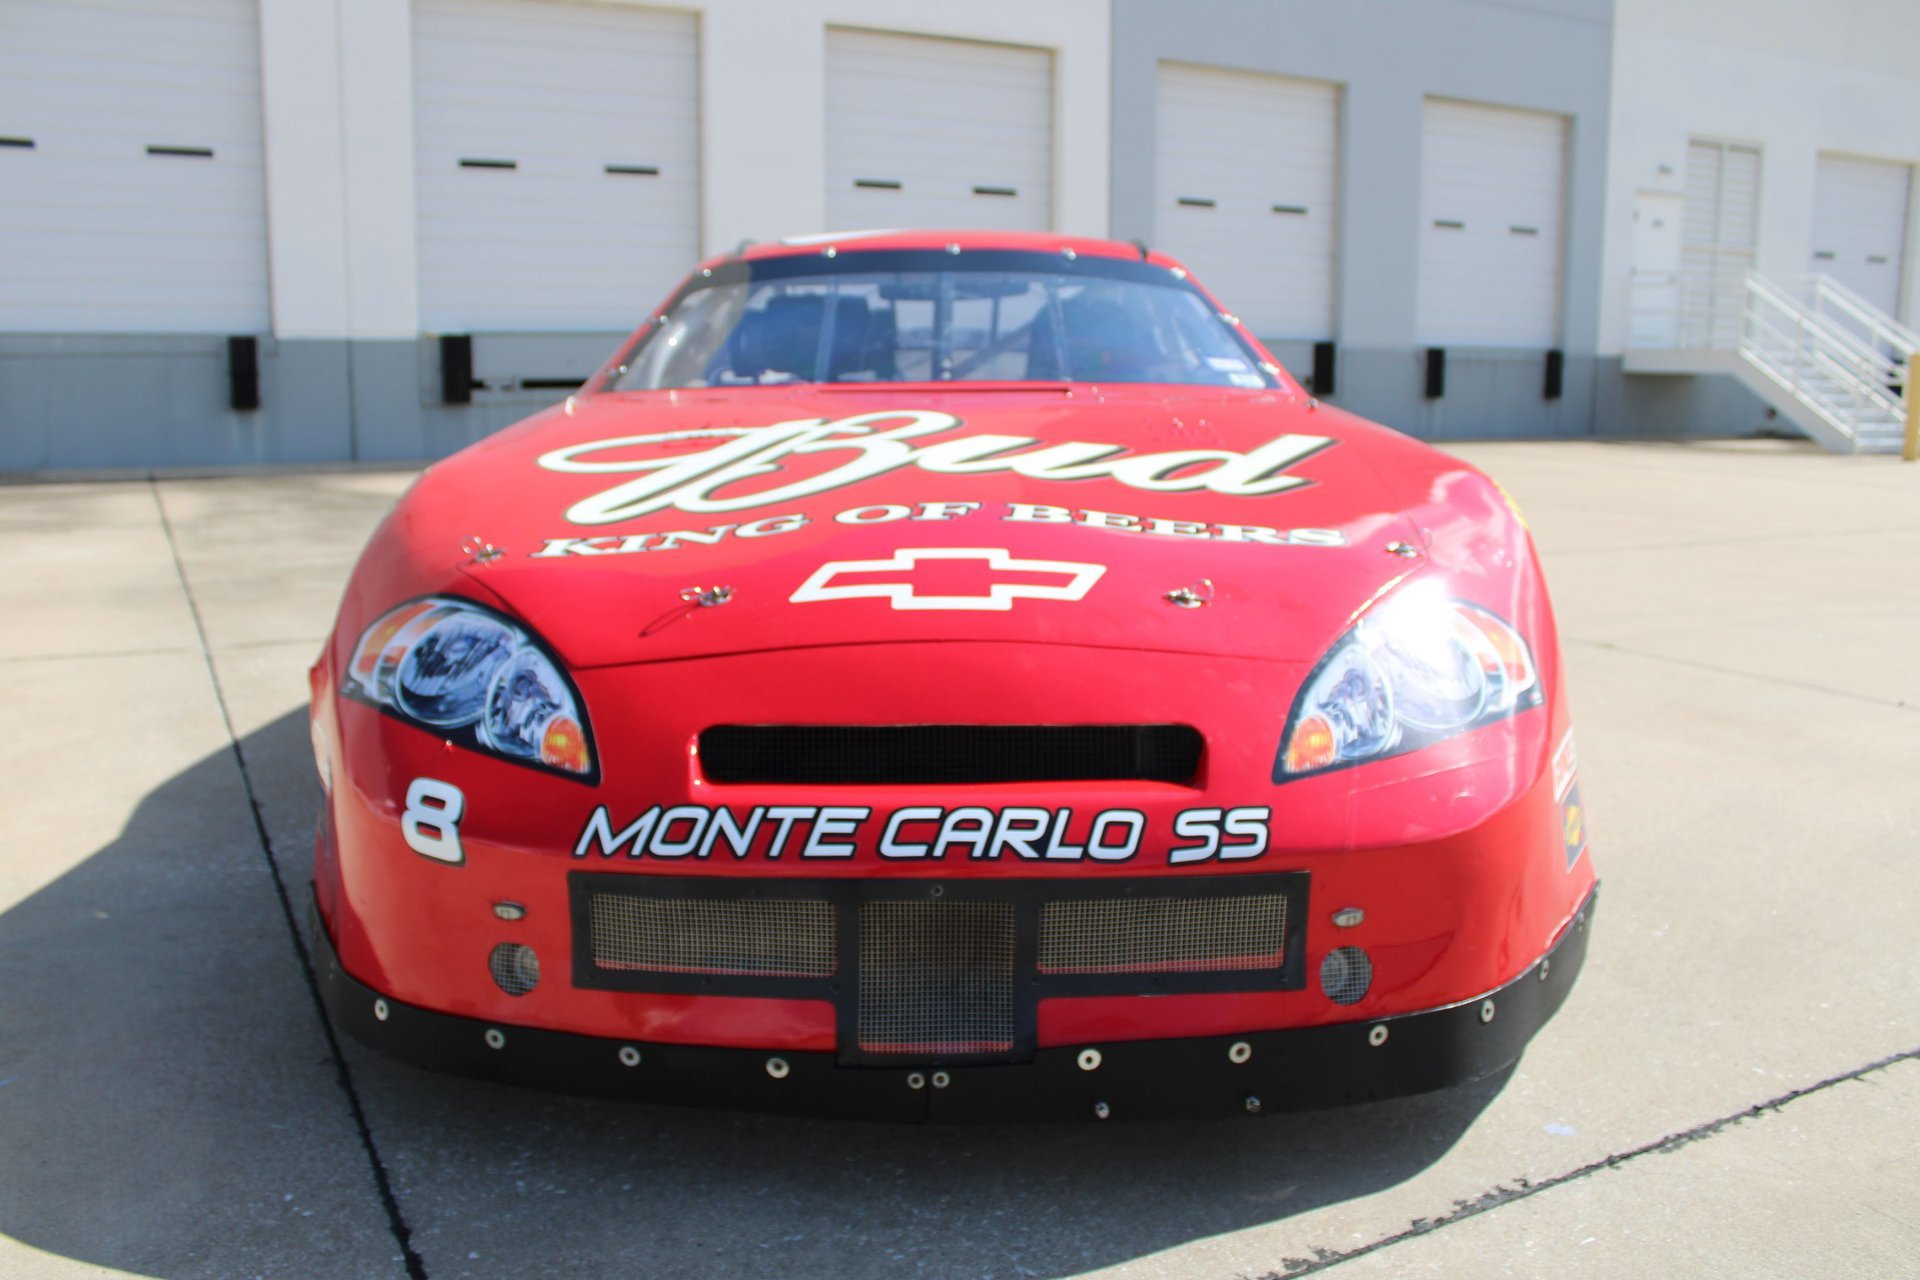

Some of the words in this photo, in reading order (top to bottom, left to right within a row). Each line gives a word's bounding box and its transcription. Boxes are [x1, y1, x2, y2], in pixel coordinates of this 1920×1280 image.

[537, 410, 1336, 525] Bud
[531, 512, 811, 558] KING
[834, 501, 982, 524] OF
[1003, 502, 1346, 548] BEERS
[401, 777, 465, 865] 8
[575, 804, 871, 860] MONTE
[877, 806, 1148, 862] CARLO
[1168, 806, 1272, 865] SS
